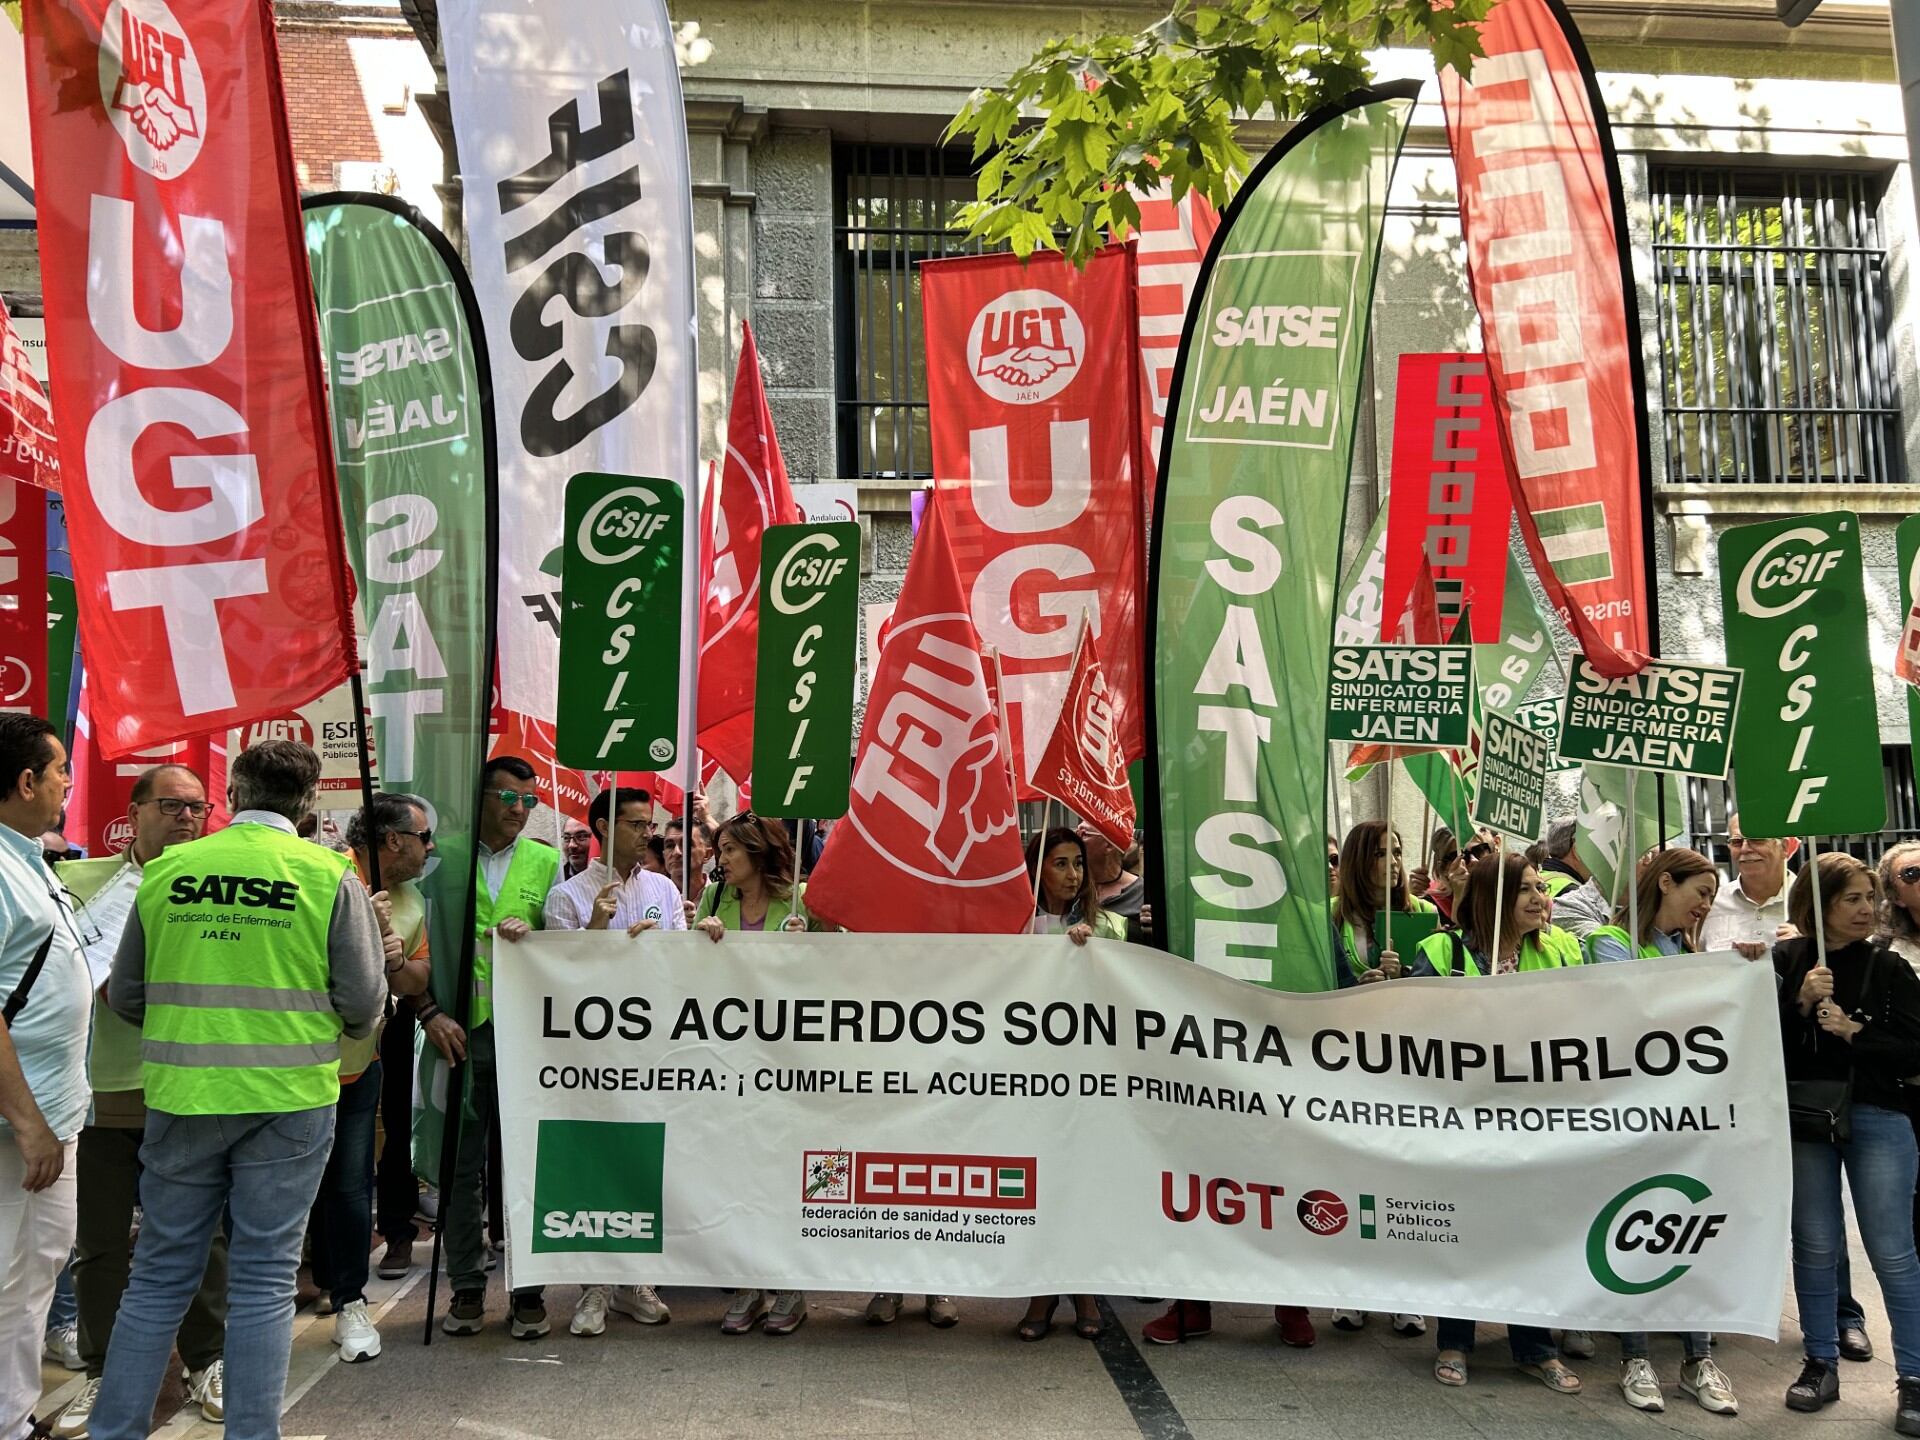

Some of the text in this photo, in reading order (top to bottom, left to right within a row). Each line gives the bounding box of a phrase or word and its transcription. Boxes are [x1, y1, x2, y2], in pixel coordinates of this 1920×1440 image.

[121, 4, 186, 101] UGT
[981, 307, 1066, 355] UGT
[1212, 305, 1342, 349] SATSE
[1016, 391, 1040, 401] JAÉN
[1199, 378, 1329, 428] JAÉN
[85, 193, 268, 717] UGT
[1426, 362, 1486, 566] CCOO
[597, 507, 671, 541] CSIF
[786, 558, 848, 587] CSIF
[1758, 550, 1844, 590] CSIF
[596, 577, 642, 759] CSIF
[1331, 650, 1467, 682] SATSE
[1330, 683, 1464, 700] SINDICATO DE
[1575, 662, 1735, 709] SATSE
[783, 624, 823, 806] CSIF
[1330, 697, 1463, 715] ENFERMERIA
[1573, 695, 1688, 722] SINDICATO
[1700, 707, 1726, 727] DE
[1778, 624, 1829, 824] CSIF
[323, 741, 357, 749] Servicio
[1190, 495, 1287, 982] SATSE
[1351, 715, 1439, 741] JAEN
[1570, 712, 1722, 743] ENFERMERIA
[1487, 718, 1546, 776] SATSE
[1593, 733, 1695, 769] JAEN
[1483, 773, 1540, 809] ENFERMERIA
[1484, 755, 1529, 786] SINDICATO
[1530, 777, 1542, 793] DE
[110, 824, 135, 838] UG
[1490, 798, 1530, 834] JAEN
[168, 875, 299, 911] SATSE
[167, 912, 291, 929] Sindicato de Enfermería
[200, 929, 240, 941] JAÉN
[542, 996, 1729, 1083] LOS ACUERDOS SON PARA CUMPLIRLOS
[538, 1065, 728, 1091] CONSEJERA:
[754, 1067, 873, 1093] CUMPLE
[883, 1070, 919, 1094] EL
[927, 1071, 1070, 1097] ACUERDO
[1079, 1073, 1117, 1097] DE
[1127, 1075, 1267, 1116] PRIMARIA
[1277, 1093, 1296, 1118] Y
[1306, 1096, 1464, 1130] CARRERA
[1474, 1105, 1720, 1132] PROFESIONAL
[865, 1163, 992, 1198] CCOO
[801, 1206, 1036, 1226] federación de sanidad y sectores
[1162, 1171, 1285, 1230] UGT
[1386, 1198, 1455, 1212] Servicios
[542, 1210, 654, 1239] SATSE
[801, 1226, 1005, 1244] sociosanitarios de Andalucía
[1386, 1213, 1451, 1228] Públicos
[1615, 1210, 1728, 1255] CSIF
